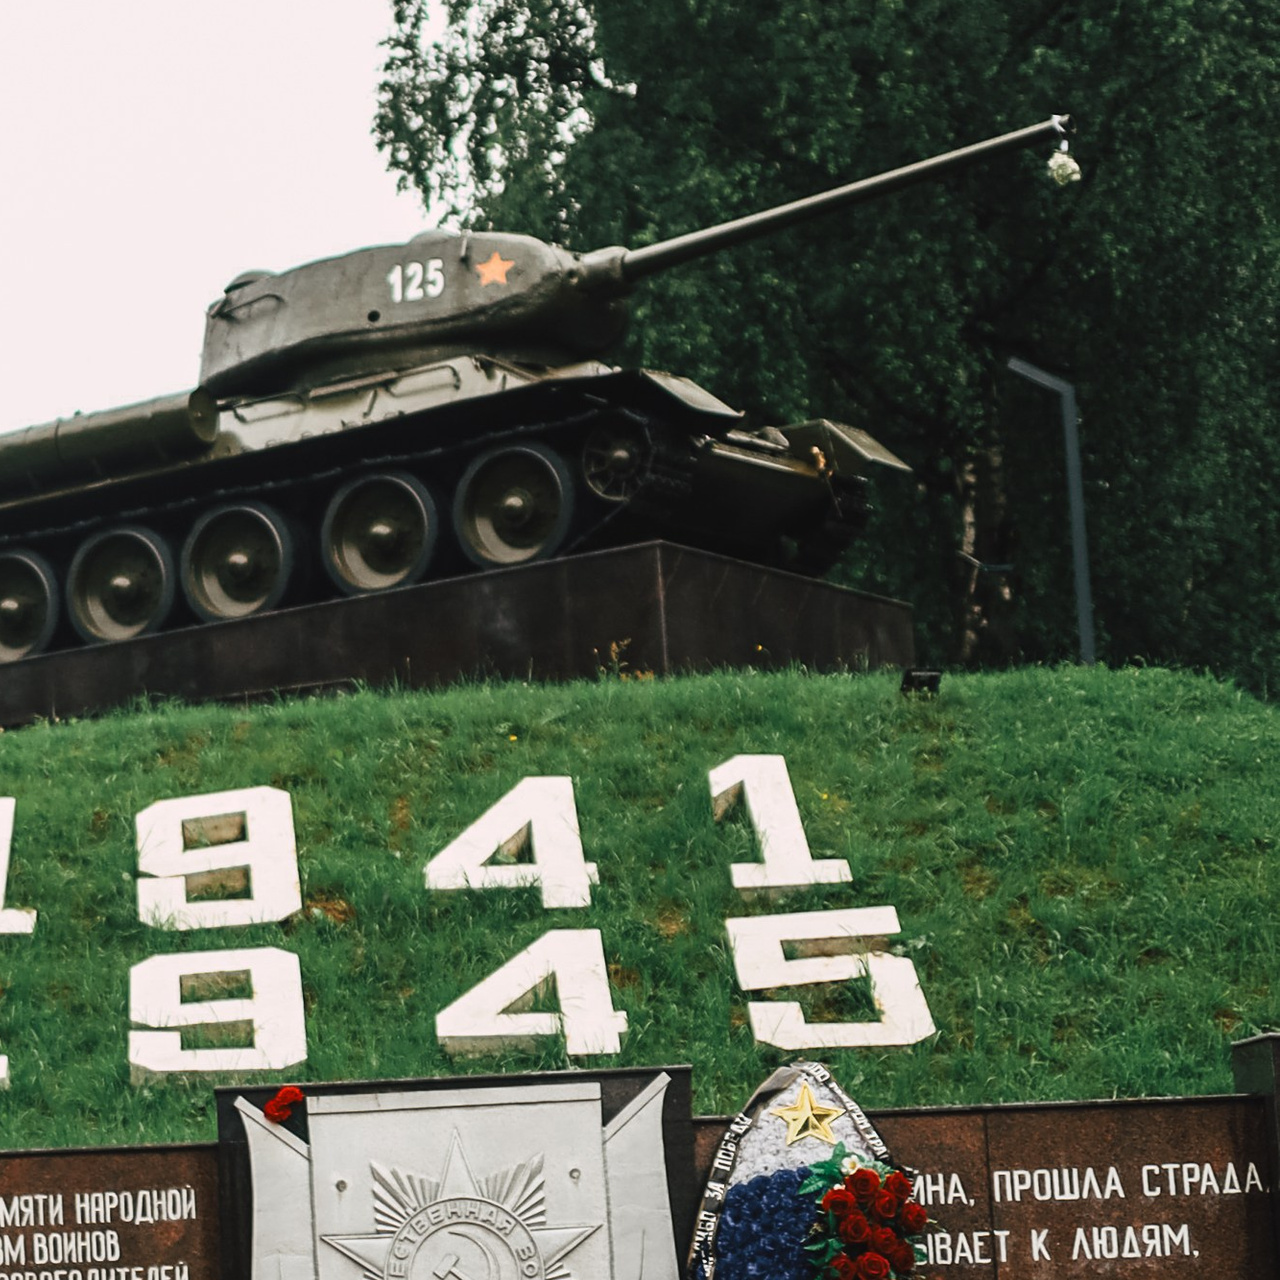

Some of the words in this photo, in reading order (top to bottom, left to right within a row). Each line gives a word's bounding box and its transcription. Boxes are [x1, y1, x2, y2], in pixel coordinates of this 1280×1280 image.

[387, 257, 445, 303] 125
[713, 1112, 753, 1172] ПОБЕДУ
[74, 1184, 197, 1225] НАРОДНОЙ
[704, 1181, 725, 1201] ЗА
[993, 1166, 1125, 1203] ПРОШЛА
[32, 1229, 121, 1265] ВОИНОВ
[914, 1229, 1011, 1266] ЫВАЕТ
[1031, 1228, 1052, 1262] К
[1071, 1223, 1200, 1261] ЛЮДЯМ,
